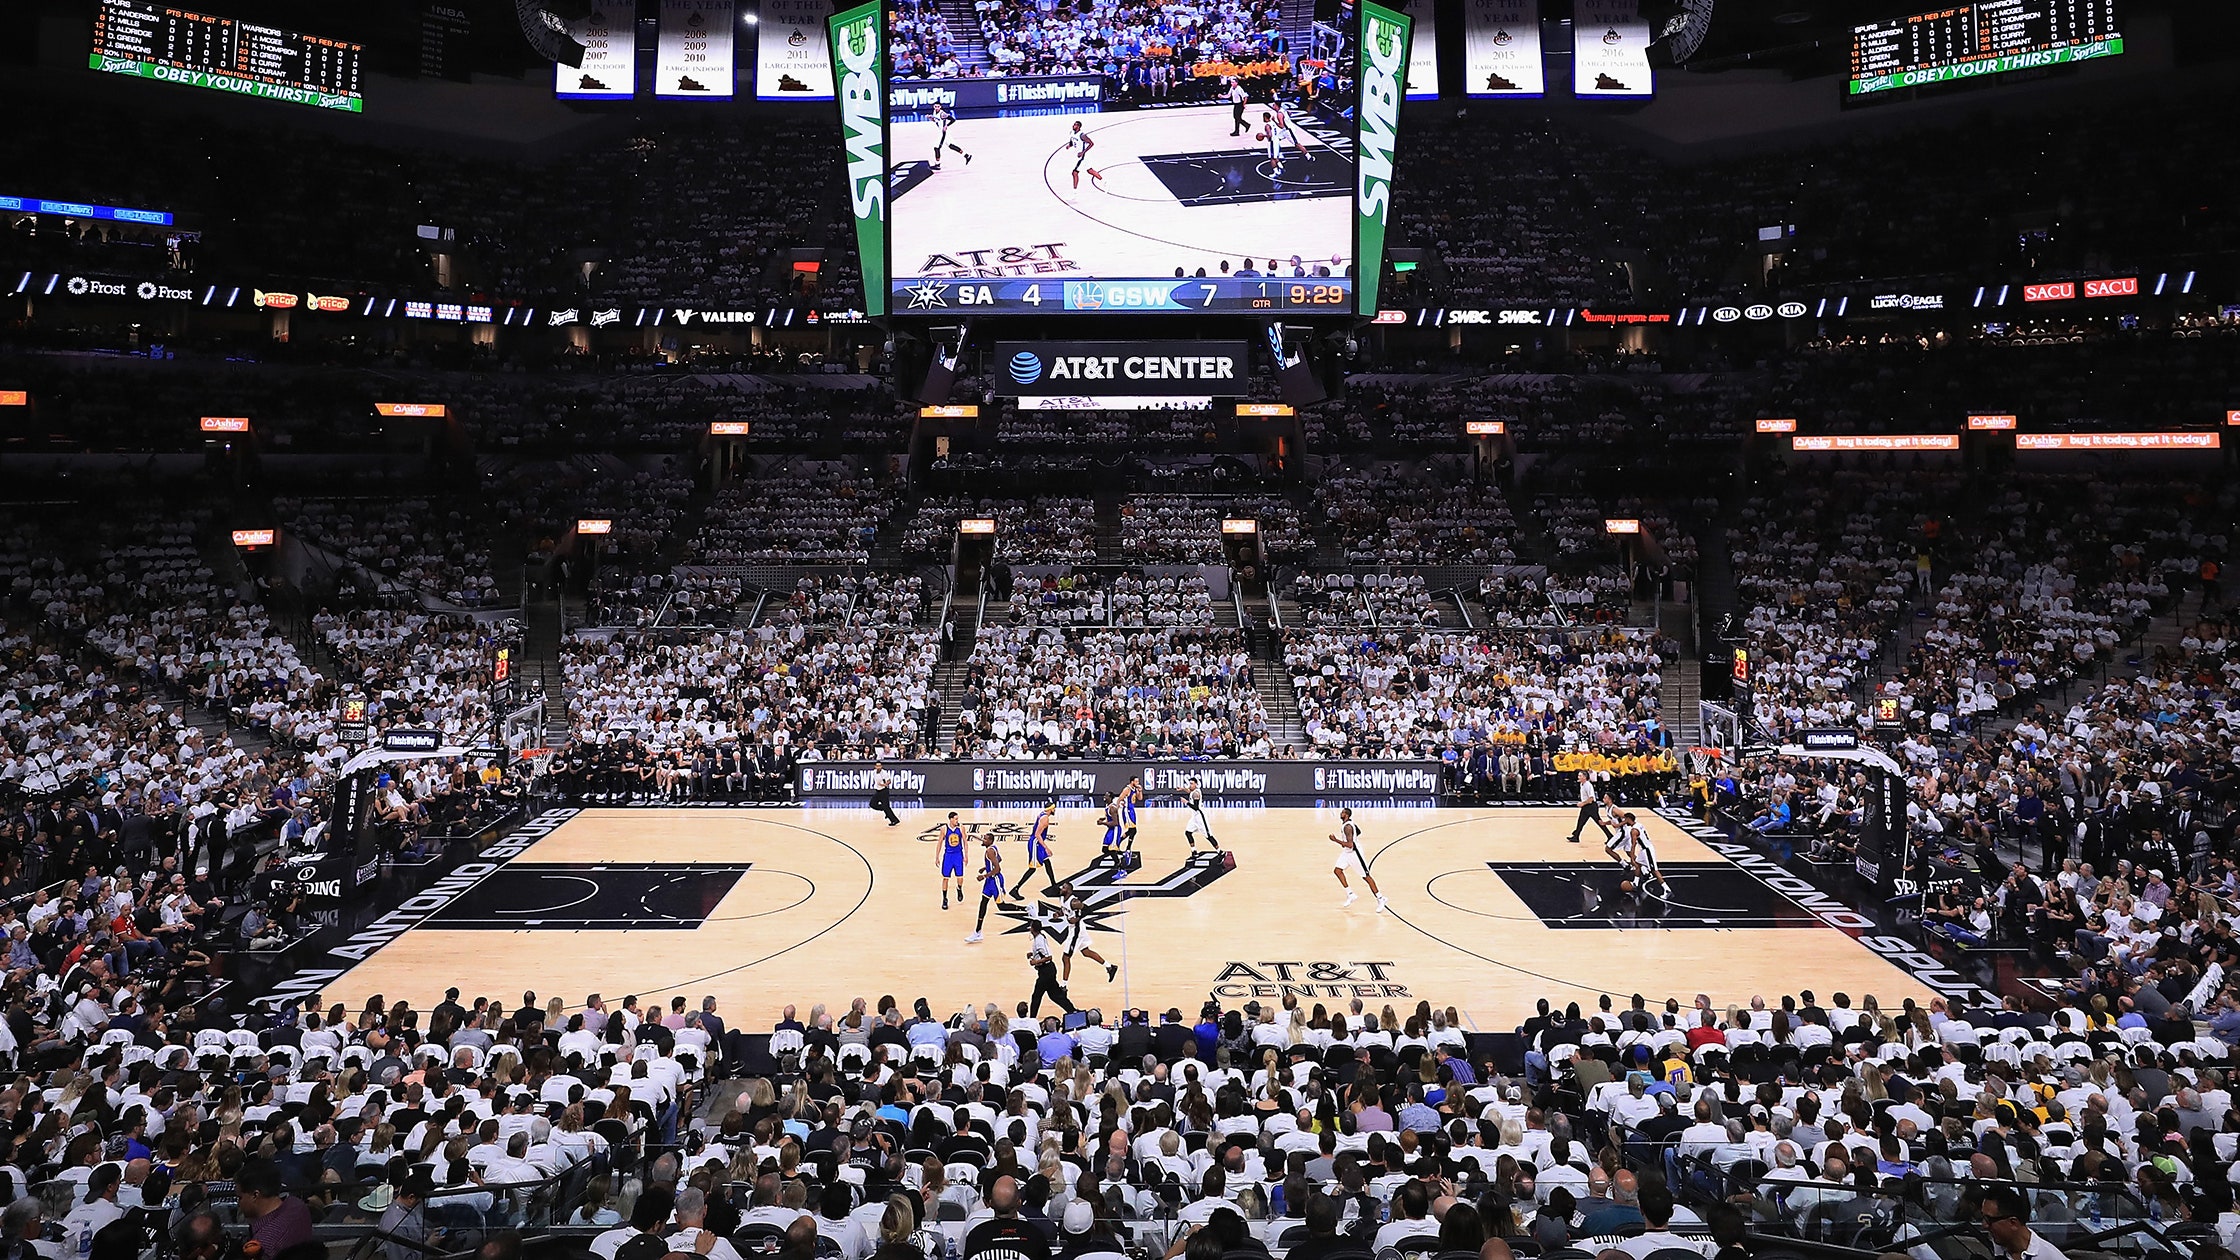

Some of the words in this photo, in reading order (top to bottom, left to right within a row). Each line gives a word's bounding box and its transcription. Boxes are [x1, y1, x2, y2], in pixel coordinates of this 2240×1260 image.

[117, 17, 140, 27] MILLS
[118, 9, 160, 23] ANDERSON
[780, 15, 815, 25] YEAR
[1483, 13, 1520, 24] YEAR
[1999, 11, 2041, 25] THOMPSON
[115, 25, 153, 38] ALDRIDGE
[241, 23, 282, 37] WARRIORS
[586, 28, 609, 37] 2005
[684, 30, 708, 40] 2008
[1854, 23, 1879, 34] SPURS
[1868, 27, 1904, 40] ANDERSON
[116, 33, 142, 44] GREEN
[586, 39, 608, 49] 2006
[2001, 37, 2032, 49] DURANT
[114, 42, 152, 54] SIMMONS
[259, 43, 298, 56] THOMPSON
[684, 41, 708, 51] 2009
[1601, 47, 1625, 58] 2016
[1867, 43, 1899, 55] ALDRIDGE
[2072, 41, 2105, 61] Sprite
[259, 51, 283, 61] GREEN
[585, 51, 608, 60] 2007
[683, 53, 706, 63] 2010
[786, 50, 809, 60] 2011
[1492, 50, 1516, 61] 2015
[102, 60, 137, 72] Sprite
[258, 59, 283, 69] CURRY
[665, 65, 693, 73] LARGE
[696, 65, 726, 73] INDOOR
[764, 62, 796, 70] LARGE
[797, 62, 829, 70] INDOOR
[1903, 66, 1949, 85] OBEY
[1950, 58, 1998, 78] YOUR
[2000, 48, 2065, 70] THIRST
[257, 67, 288, 78] DURANT
[153, 65, 204, 85] OBEY
[206, 71, 253, 95] YOUR
[256, 82, 315, 104] THIRST
[1861, 75, 1889, 93] Sprite
[320, 96, 348, 108] Sprite
[918, 242, 1068, 273] AT&T
[921, 259, 1081, 279] ENTER
[90, 280, 126, 296] Frost
[158, 285, 193, 300] Frost
[1258, 282, 1267, 298] 1
[2026, 283, 2073, 300] SACU
[2086, 279, 2135, 296] SACU
[957, 285, 994, 305] SA
[1021, 284, 1042, 307] 4
[1107, 286, 1168, 307] GSW
[1200, 284, 1218, 307] 7
[1289, 285, 1343, 305] 9:29
[406, 301, 431, 309] 1200
[437, 303, 461, 311] 1200
[1251, 299, 1271, 309] QTR
[1871, 298, 1900, 309] LUCKY
[1913, 295, 1943, 305] EAGLE
[467, 305, 491, 313] 1200
[1717, 309, 1737, 319] KIA
[1749, 307, 1769, 318] KIA
[1781, 304, 1802, 315] KIA
[701, 310, 755, 323] VALERO
[1049, 356, 1120, 379] AT&T
[1123, 356, 1234, 379] CENTER
[400, 405, 426, 415] Ashley
[213, 418, 244, 430] Ashley
[1982, 417, 2012, 427] Ashley
[1804, 437, 1831, 447] Ashley
[2029, 436, 2063, 447] Ashley
[2069, 435, 2091, 446] buy
[2093, 435, 2101, 444] it
[2140, 436, 2159, 446] get
[2161, 435, 2170, 444] it
[2172, 434, 2210, 446] today!
[243, 532, 272, 542] Ashley
[1735, 658, 1747, 679] 23
[1881, 708, 1895, 719] 23
[814, 769, 926, 794] #ThisIsWWePlay
[985, 768, 1097, 793] #ThisIsWhyWePlay
[1156, 767, 1267, 793] #ThisIsWhyWePlay
[1326, 767, 1438, 793] #ThisIsWhyWePlay
[348, 791, 357, 814] NBA
[1884, 790, 1892, 814] NBA
[346, 815, 354, 832] TV
[1652, 806, 1729, 839] SAN
[1885, 815, 1893, 832] TV
[477, 806, 581, 859] SPURS
[1707, 840, 1877, 929] ANTONIO
[327, 862, 499, 961] ANTONIO
[1213, 961, 1396, 982] AT&T
[1857, 935, 2006, 1012] SPUR
[1213, 983, 1413, 999] CENTER
[230, 969, 345, 1028] AN
